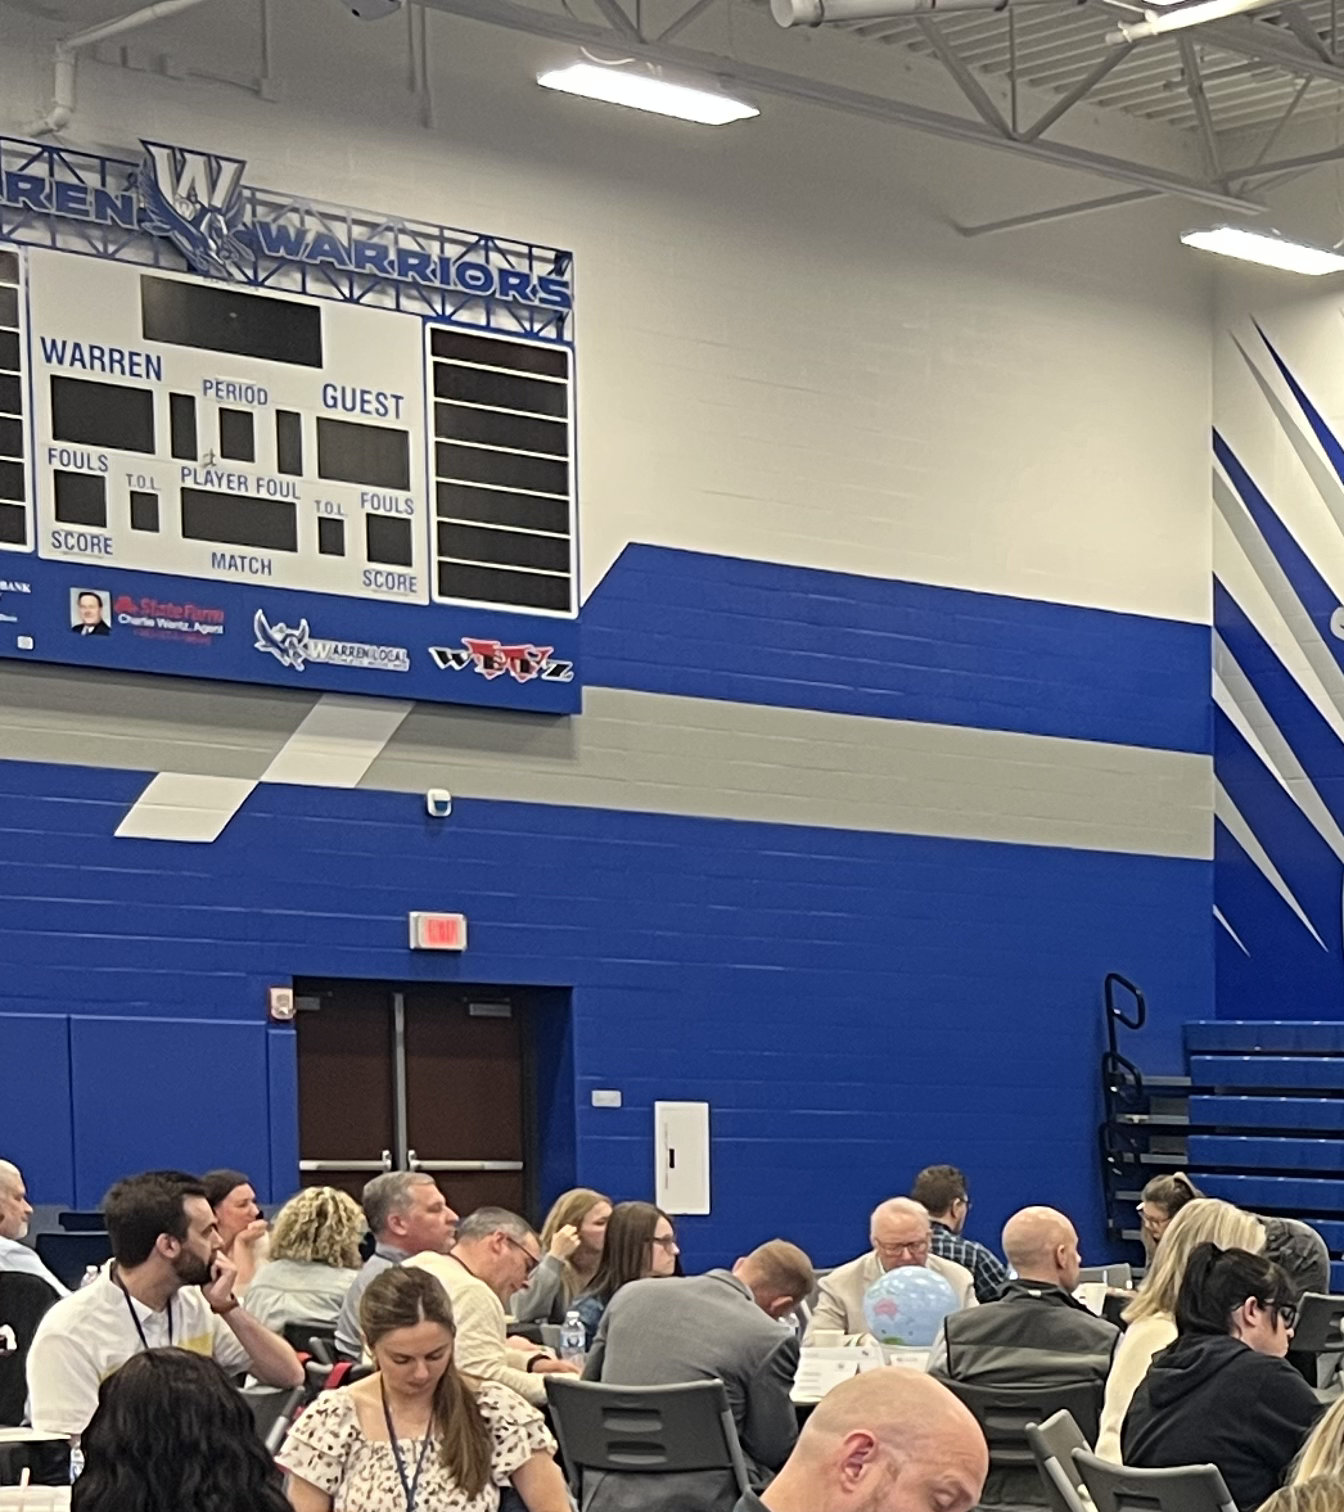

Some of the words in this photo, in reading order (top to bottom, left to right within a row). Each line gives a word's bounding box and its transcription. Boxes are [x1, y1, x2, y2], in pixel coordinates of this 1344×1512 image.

[0, 170, 139, 230] REN
[254, 219, 574, 312] WARRIORS
[40, 336, 162, 382] WARREN
[203, 378, 268, 406] PERIOD
[322, 383, 404, 419] GUEST
[48, 447, 108, 472] FOULS
[181, 466, 249, 493] PLAYER
[256, 477, 301, 500] FOUL
[360, 492, 414, 516] FOULS
[51, 531, 113, 555] SCORE
[211, 552, 272, 577] MATCH
[362, 569, 417, 594] SCORE
